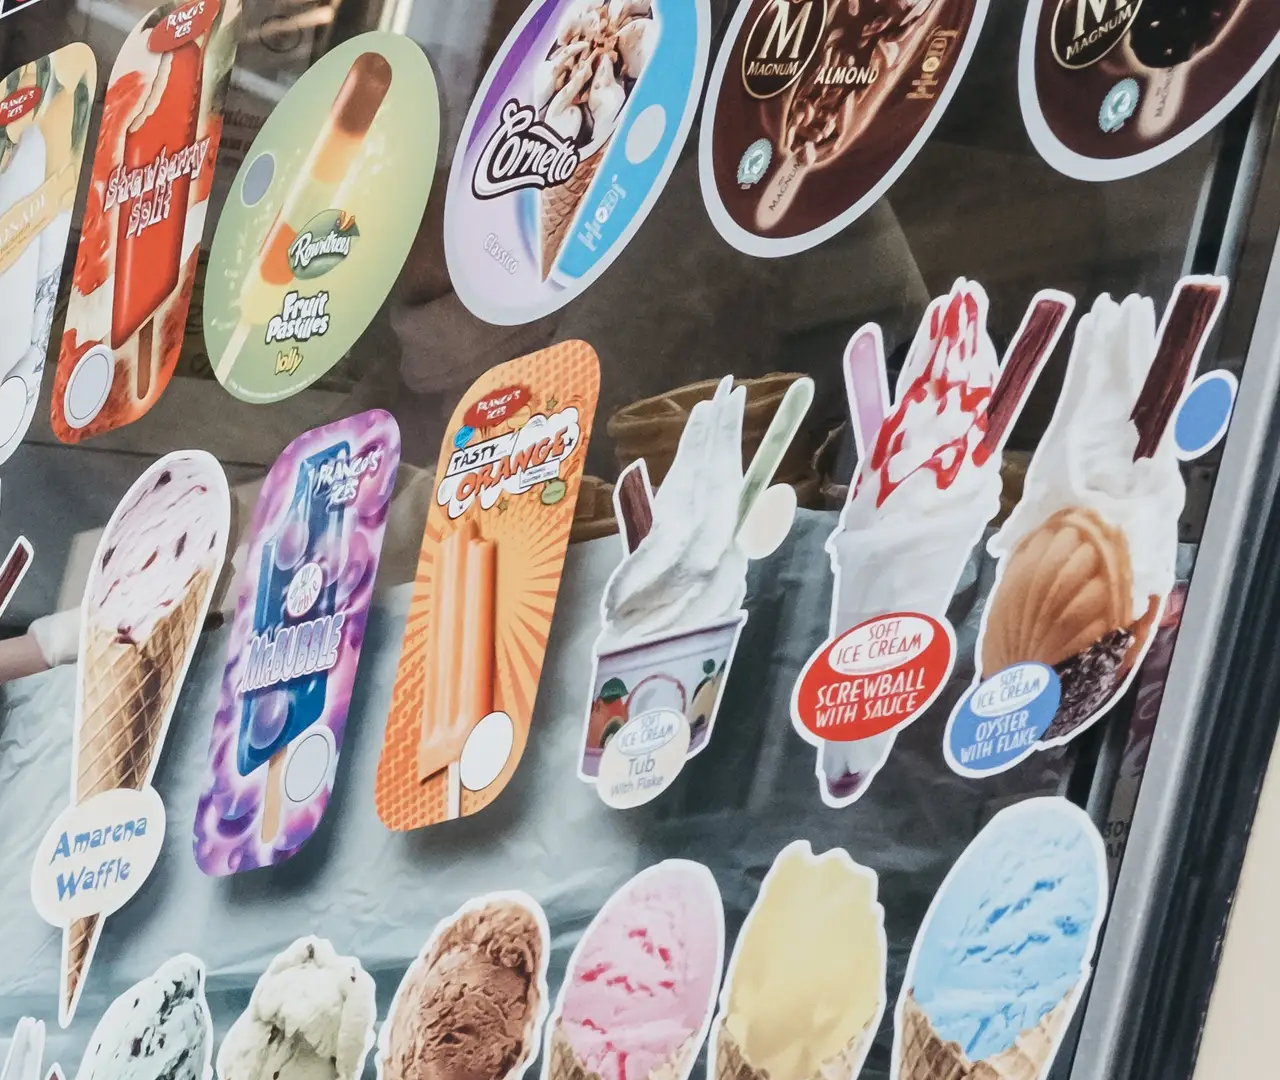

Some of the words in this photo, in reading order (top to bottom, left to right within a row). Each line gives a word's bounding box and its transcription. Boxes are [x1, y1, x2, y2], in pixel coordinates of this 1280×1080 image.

[1066, 3, 1133, 61] MAGNUM
[747, 60, 800, 77] MAGNUM
[813, 66, 879, 85] ALMOND
[473, 99, 580, 199] Cornetto
[483, 233, 520, 276] Classico
[282, 290, 329, 321] Fruit
[264, 314, 330, 345] Pastilles
[453, 443, 500, 471] TASTY
[455, 425, 569, 502] ORANGE
[867, 619, 902, 642] SOFT
[836, 644, 862, 666] ICE
[868, 632, 922, 659] CREAM
[814, 666, 926, 709] SCREWBALL
[976, 690, 998, 709] ICE
[1000, 677, 1041, 702] CREAM
[815, 703, 858, 729] WITH
[861, 692, 919, 721] SAUCE
[975, 709, 1031, 742] OYSTER
[960, 739, 993, 765] WITH
[996, 725, 1039, 755] FLAKE
[628, 752, 657, 776] Tub
[49, 816, 148, 865] Amarena
[56, 858, 130, 902] Waffle
